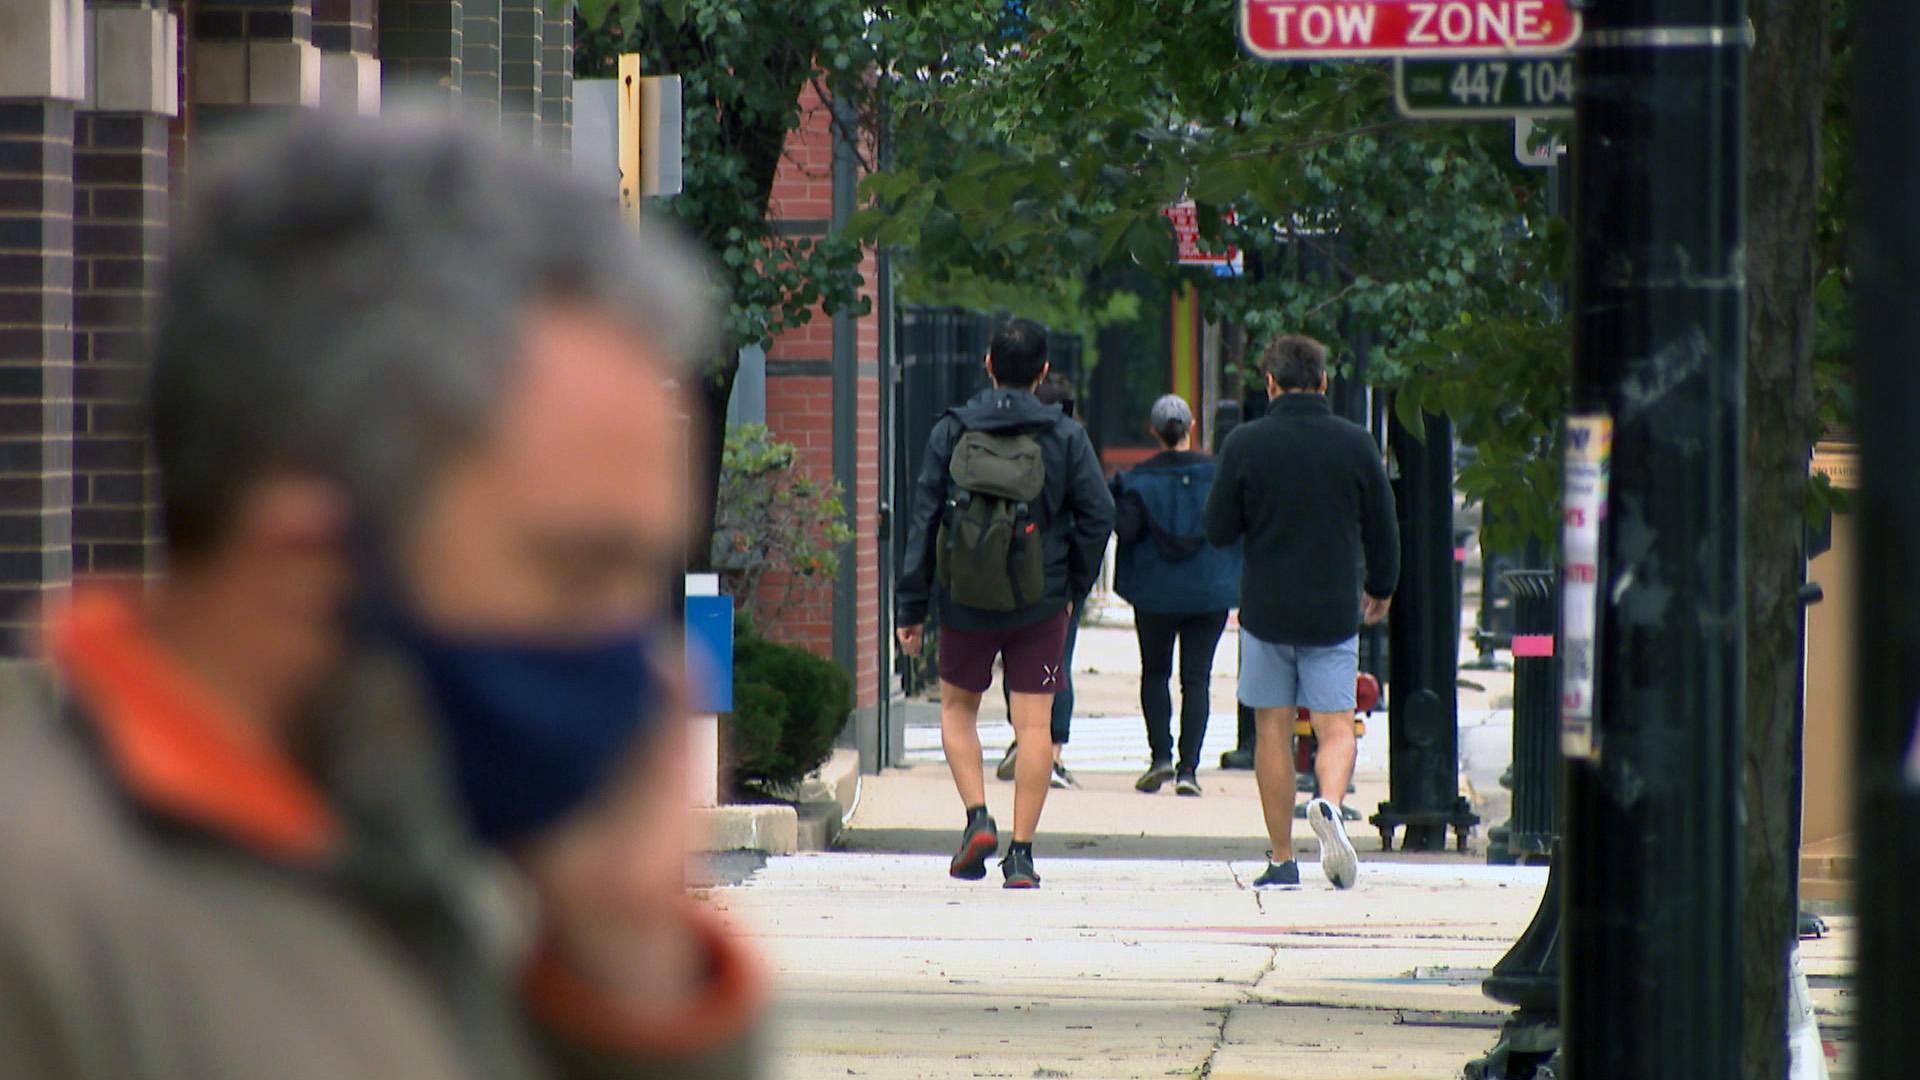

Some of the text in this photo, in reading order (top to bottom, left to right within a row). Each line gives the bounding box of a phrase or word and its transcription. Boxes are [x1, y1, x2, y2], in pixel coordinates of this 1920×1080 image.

[1267, 1, 1545, 45] TOW ZONE
[1451, 63, 1508, 103] 447
[1520, 62, 1575, 103] 104
